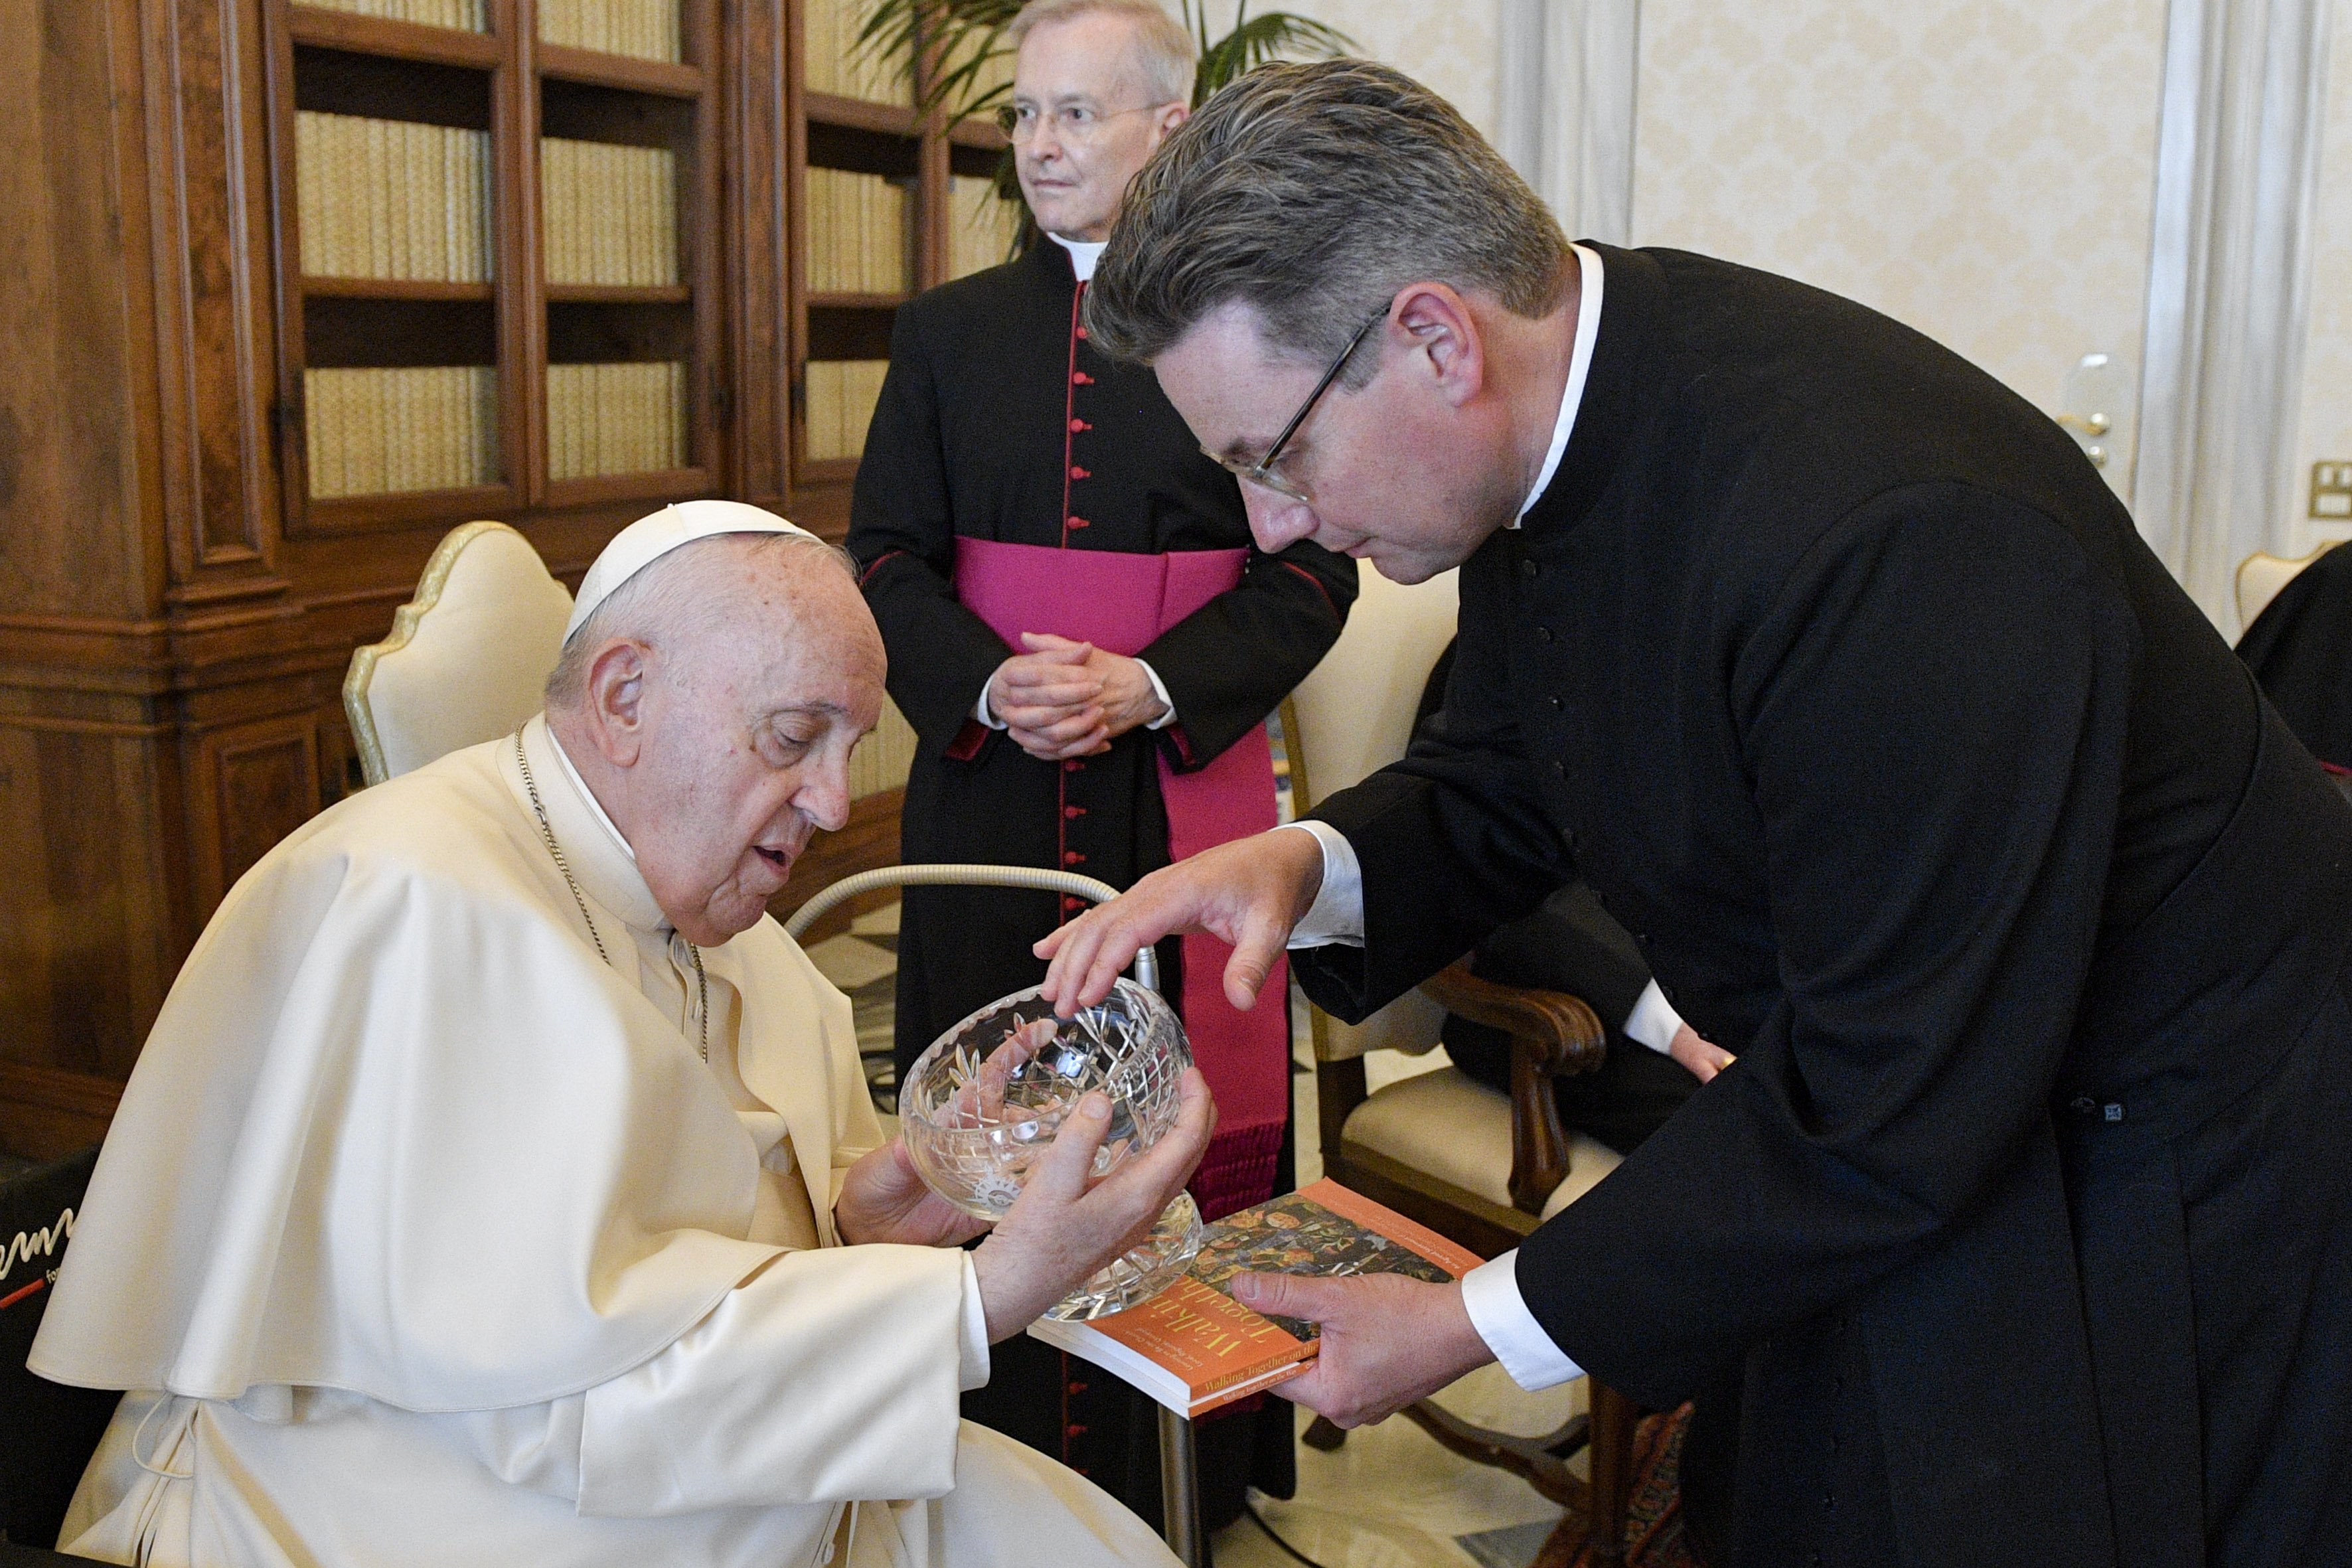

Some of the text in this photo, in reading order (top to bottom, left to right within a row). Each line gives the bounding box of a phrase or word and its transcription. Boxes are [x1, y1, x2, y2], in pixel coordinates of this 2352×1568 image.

[1144, 1296, 1241, 1357] Walkin
[1174, 1276, 1278, 1344] Togethe
[1206, 1372, 1244, 1391] Walking
[1247, 1355, 1288, 1377] Together
[1289, 1350, 1301, 1360] on
[1304, 1343, 1319, 1355] the
